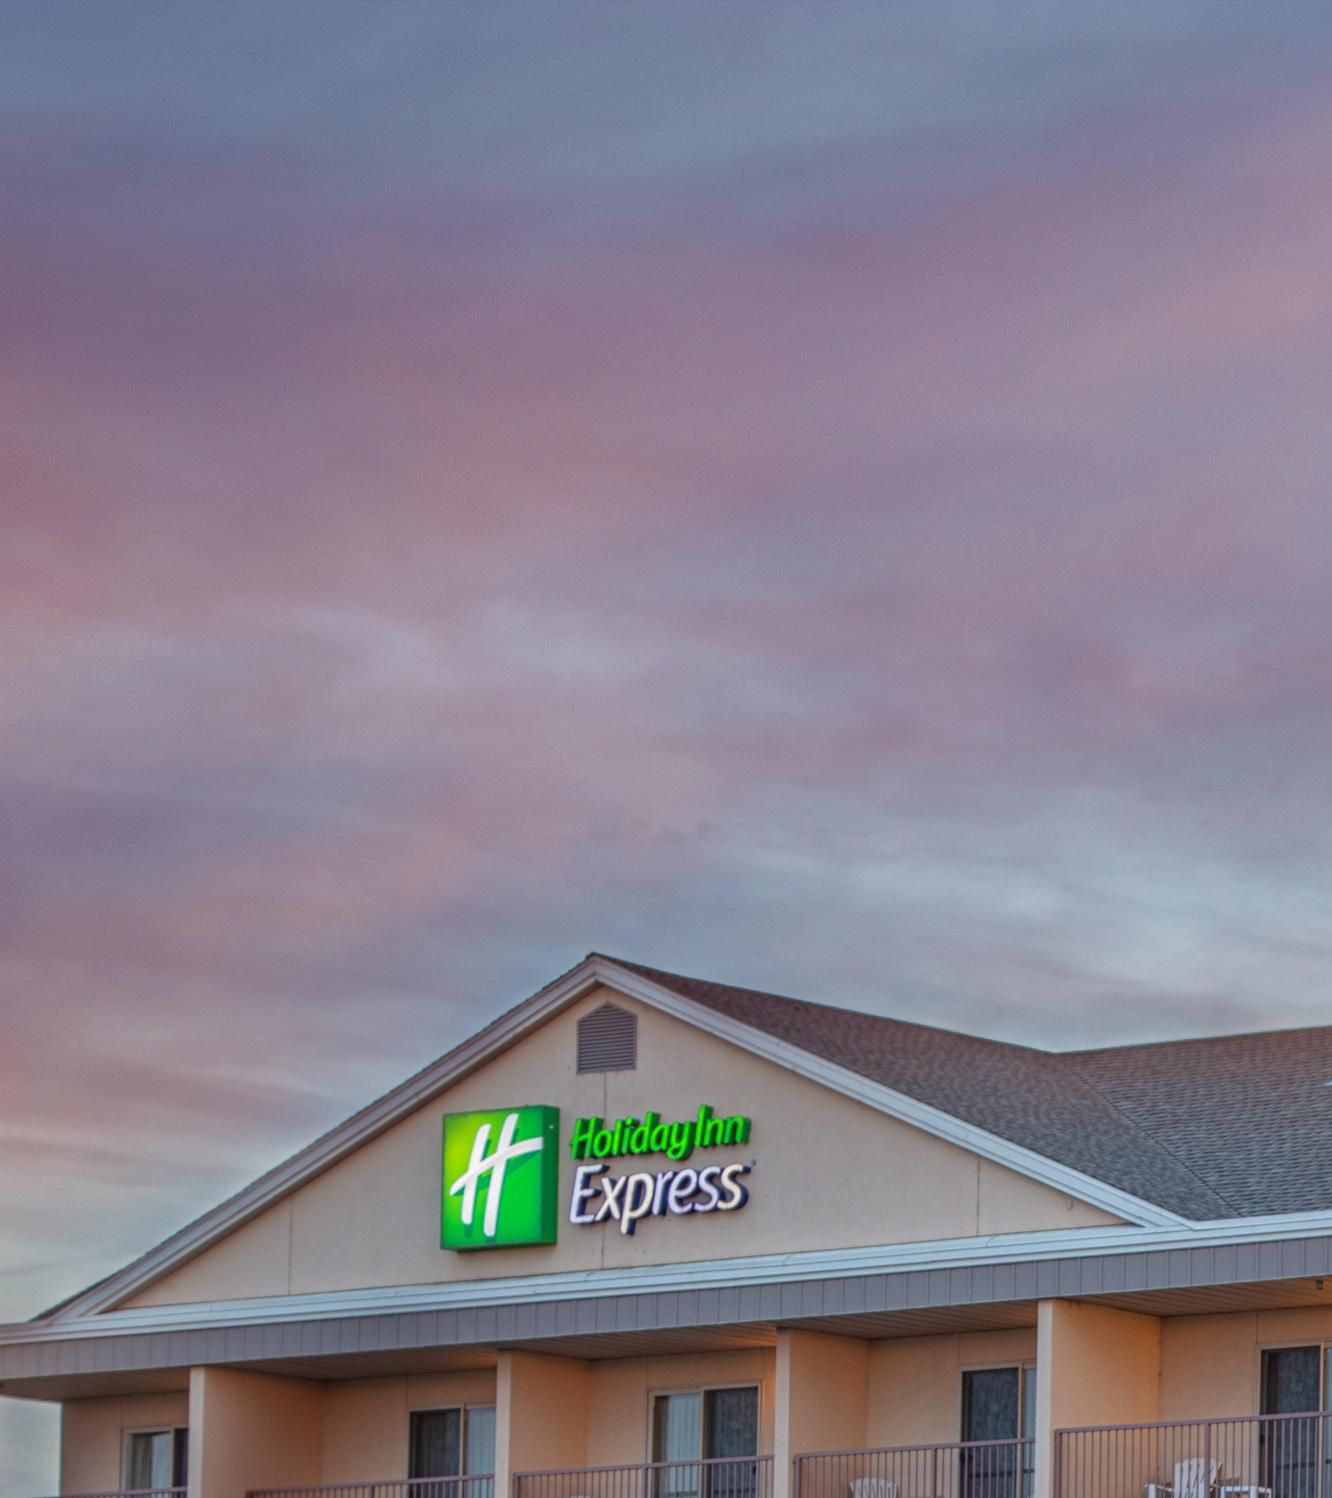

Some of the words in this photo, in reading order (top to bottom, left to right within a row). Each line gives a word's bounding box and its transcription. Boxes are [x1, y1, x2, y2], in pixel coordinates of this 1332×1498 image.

[570, 1111, 692, 1160] Holiday
[694, 1104, 751, 1148] Inn
[569, 1163, 752, 1235] Express
